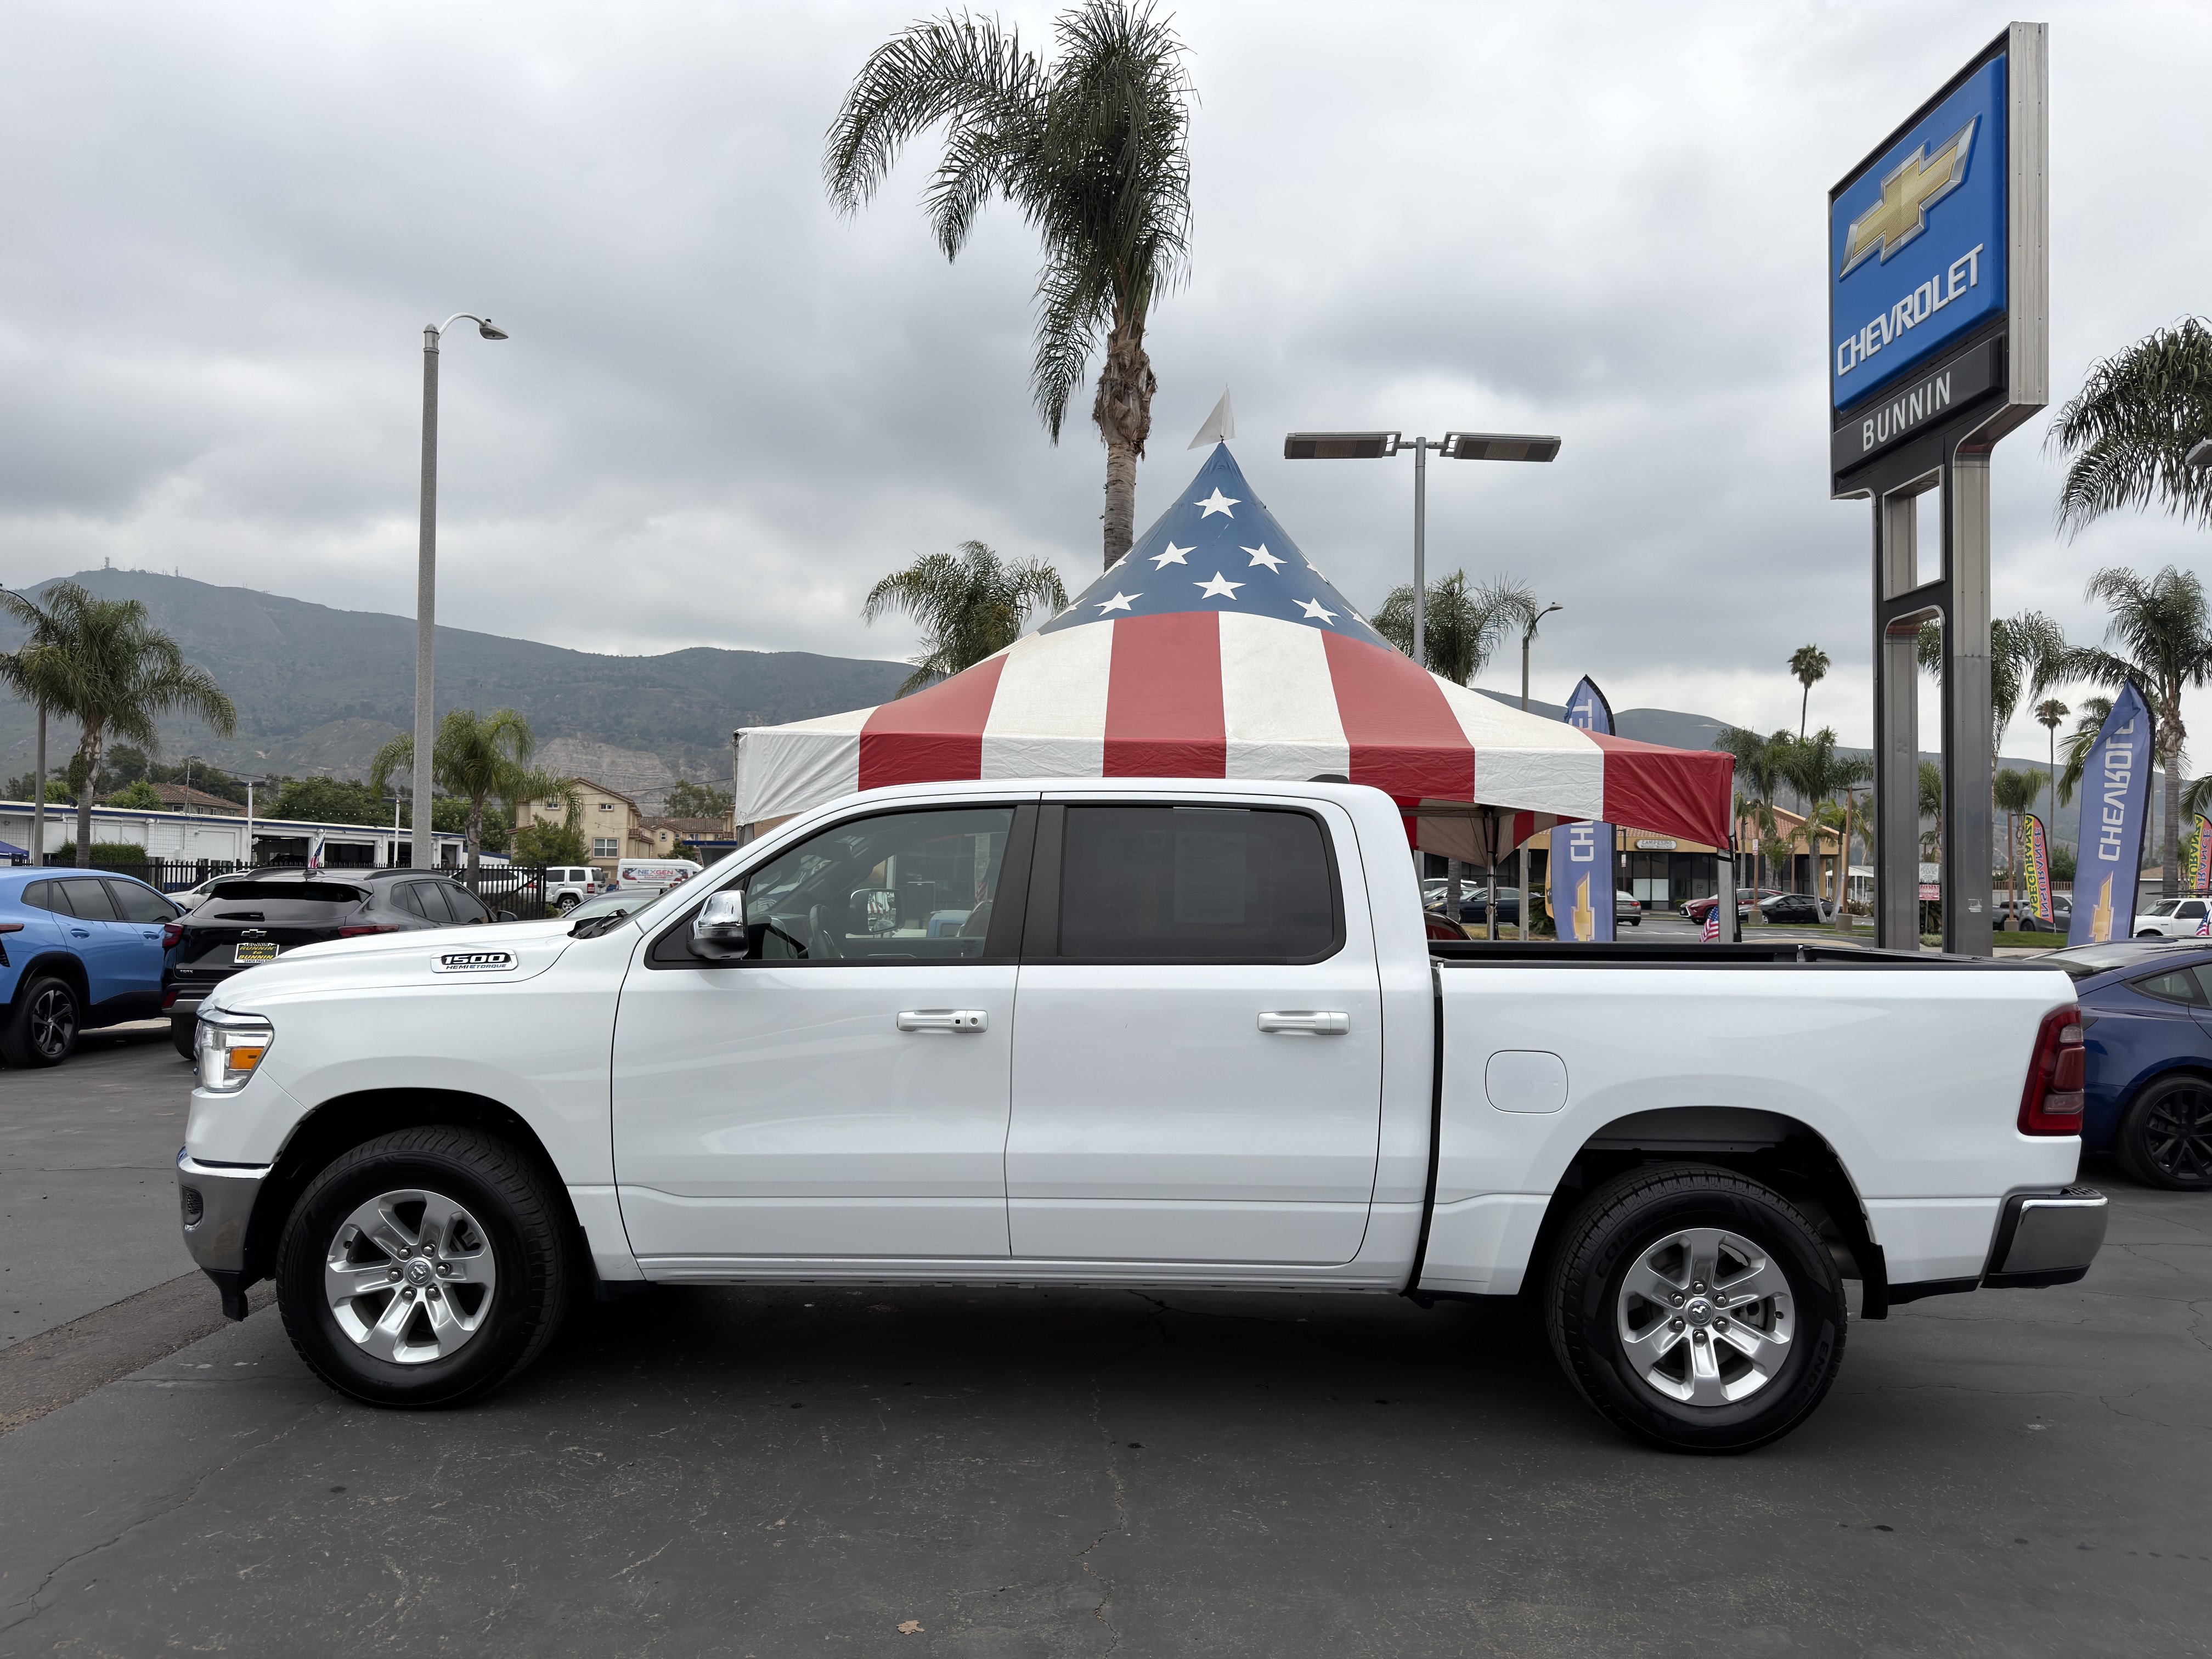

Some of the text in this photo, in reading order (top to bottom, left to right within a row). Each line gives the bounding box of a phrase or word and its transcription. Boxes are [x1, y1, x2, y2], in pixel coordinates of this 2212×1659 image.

[1837, 243, 1984, 376] CHEVROLET
[1863, 371, 1950, 452] BUNNIN
[445, 954, 506, 964] 1500
